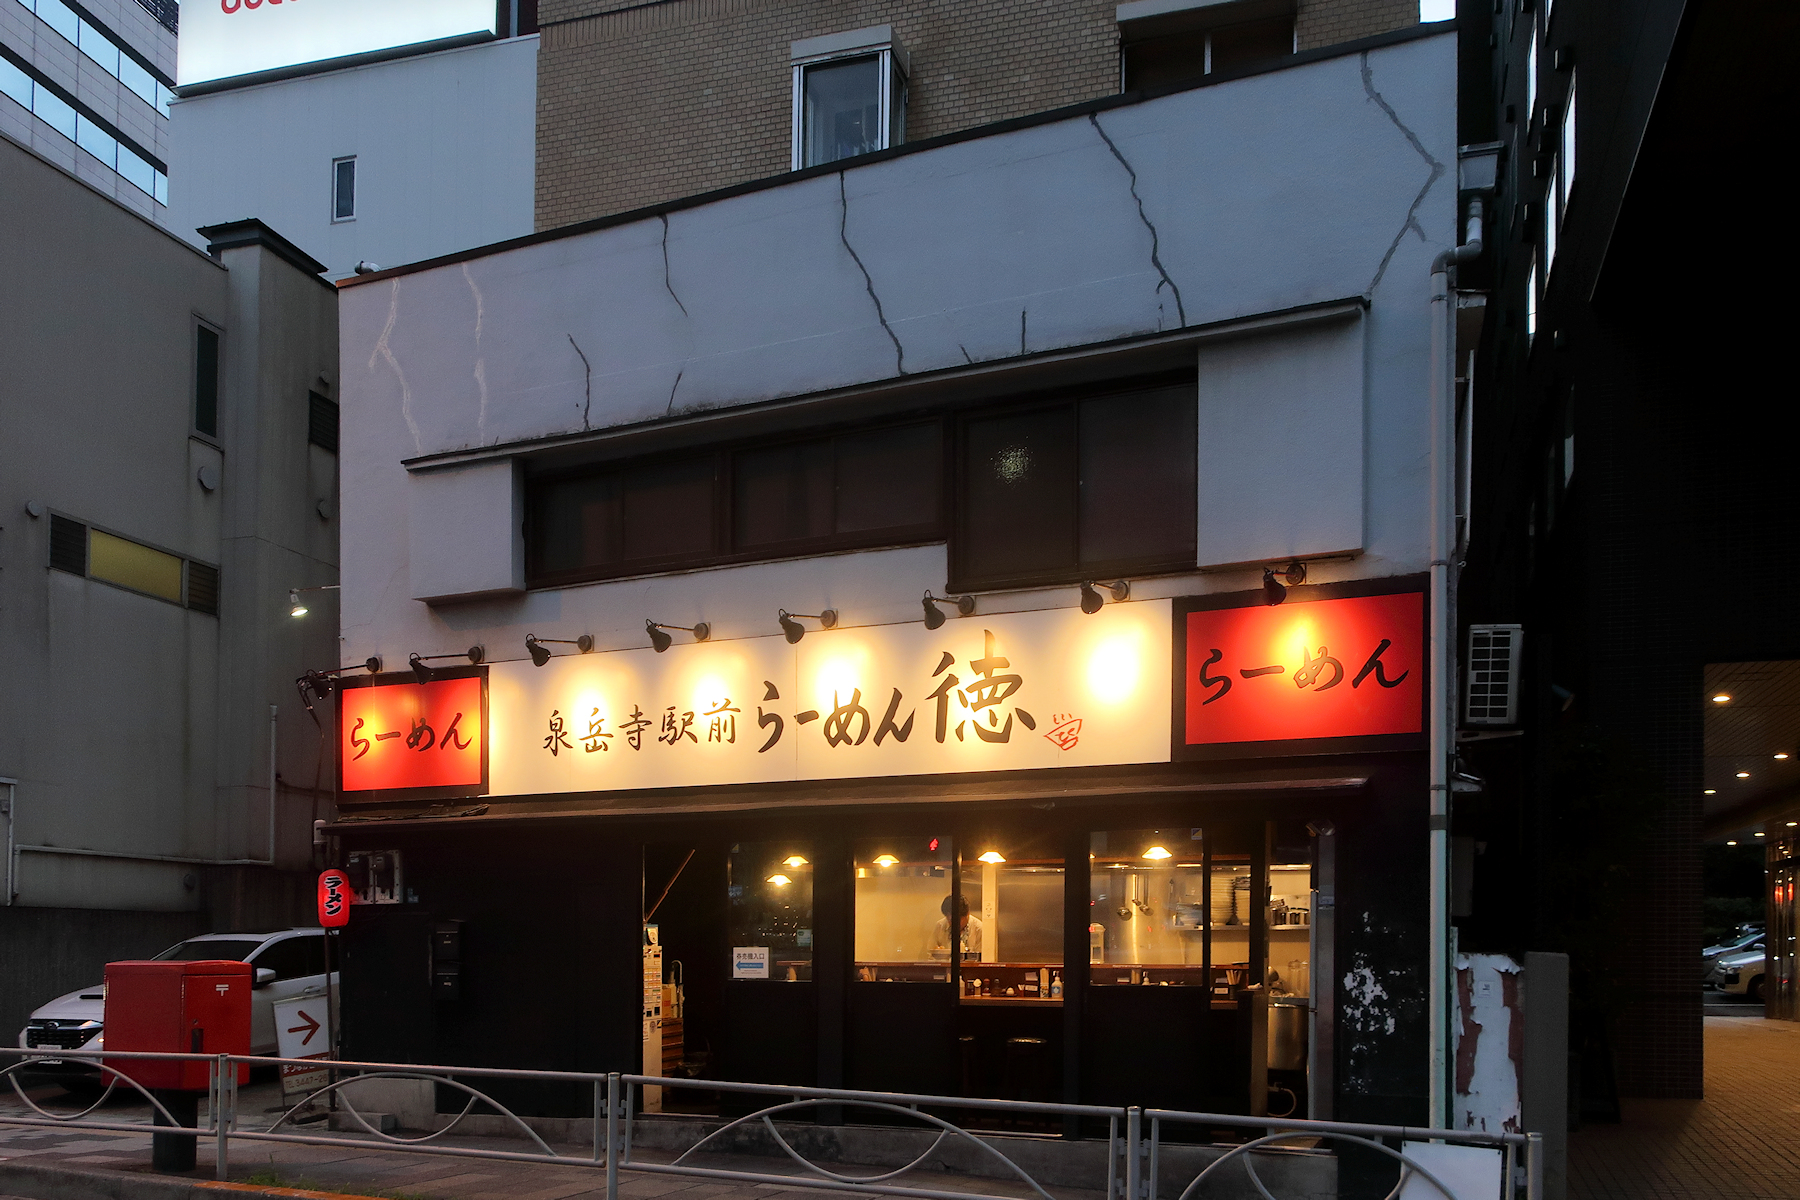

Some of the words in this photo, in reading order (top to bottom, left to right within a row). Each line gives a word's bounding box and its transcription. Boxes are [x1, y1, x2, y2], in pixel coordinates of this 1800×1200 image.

[1198, 638, 1410, 706] らーめん
[350, 712, 473, 761] らーめん
[324, 876, 343, 916] ラーメン
